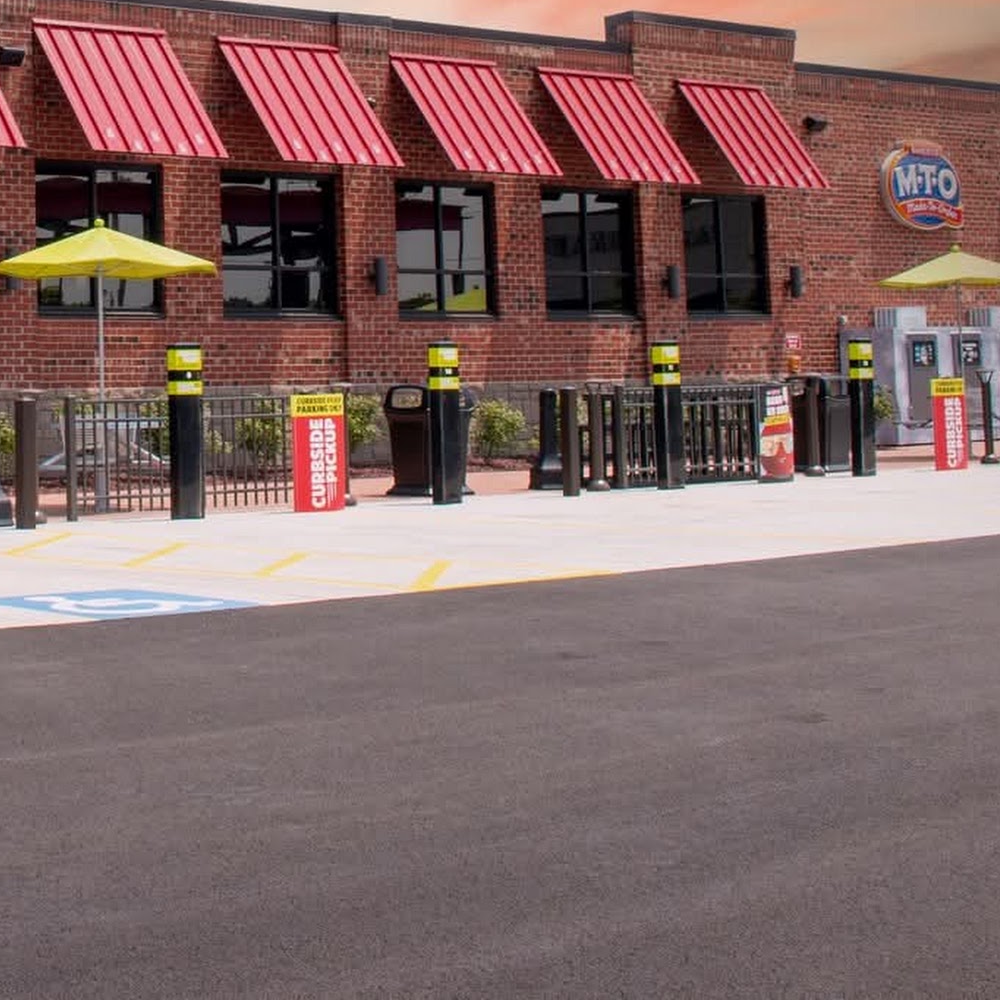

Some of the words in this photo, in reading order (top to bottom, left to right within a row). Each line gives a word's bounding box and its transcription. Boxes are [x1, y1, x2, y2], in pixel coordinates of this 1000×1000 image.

[296, 405, 328, 413] PARKING
[943, 397, 958, 468] CURBSIDE
[309, 418, 327, 508] CURBSIDE
[324, 418, 338, 483] PICKUP
